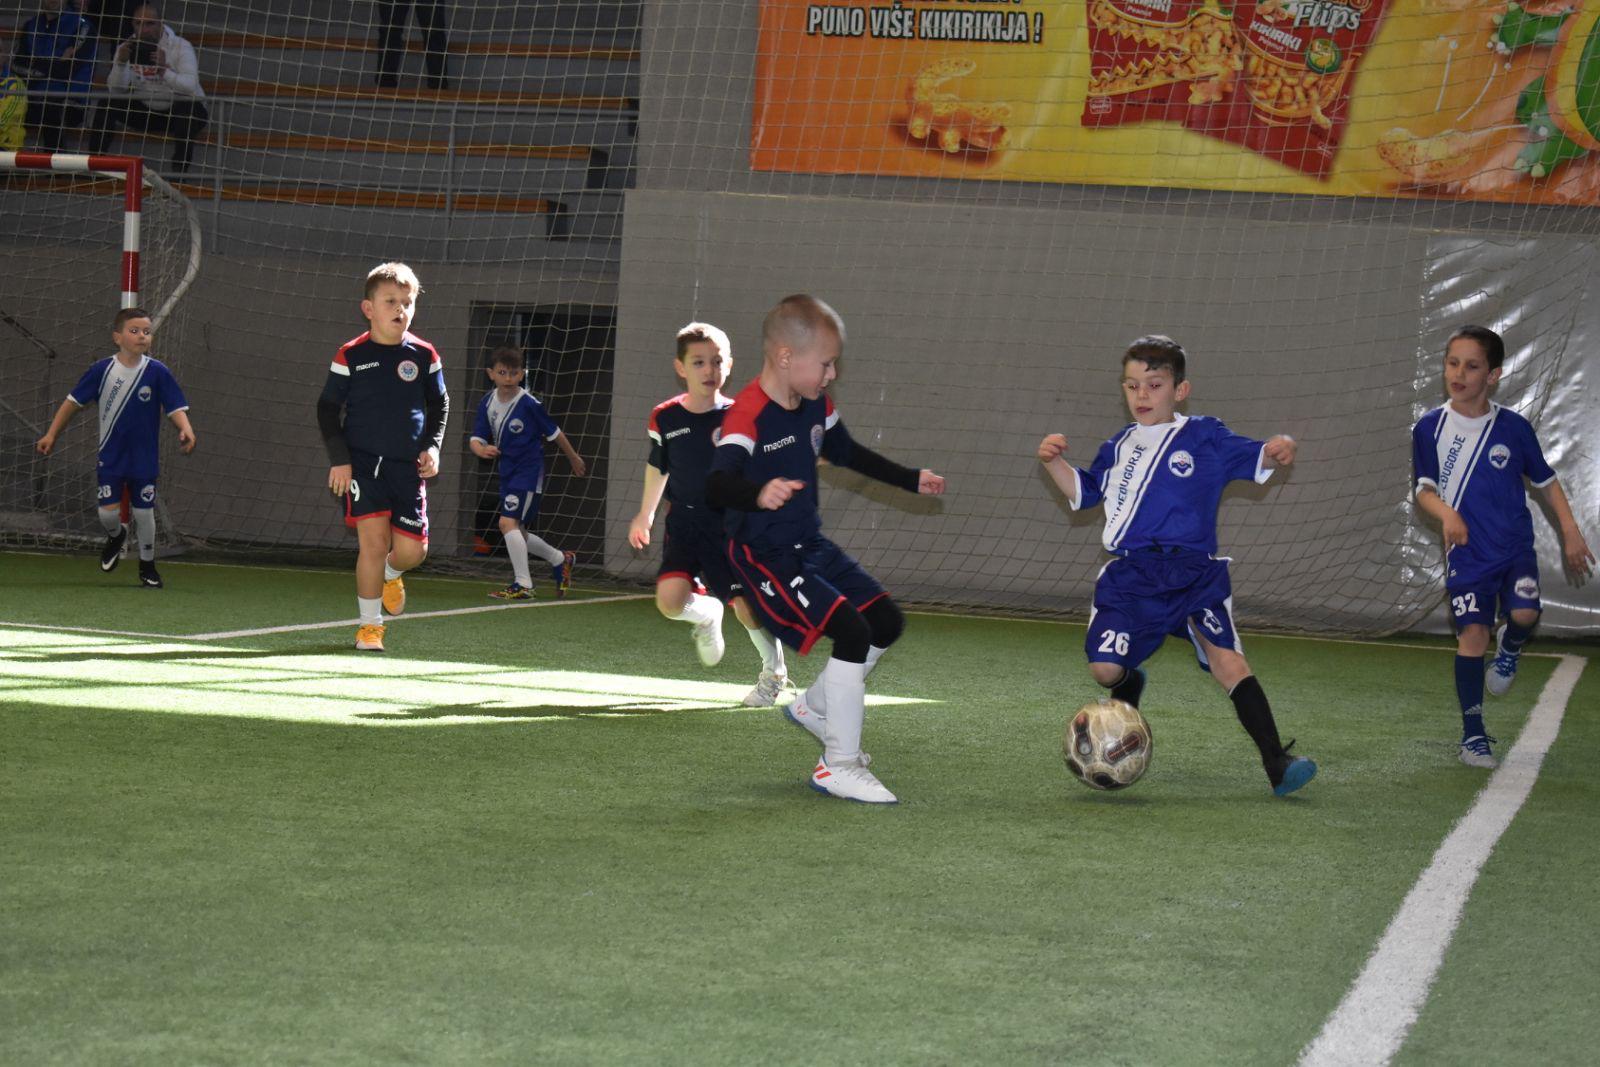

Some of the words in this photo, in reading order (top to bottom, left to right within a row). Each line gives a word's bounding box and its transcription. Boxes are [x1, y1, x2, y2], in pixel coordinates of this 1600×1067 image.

[808, 6, 866, 36] PUNO
[871, 2, 914, 38] VIŠE
[919, 9, 1028, 42] KIKIRIKIJA
[1293, 1, 1361, 34] Flips
[763, 434, 796, 453] macron
[350, 478, 361, 502] 9
[1452, 591, 1480, 617] 32
[1097, 629, 1130, 657] 26
